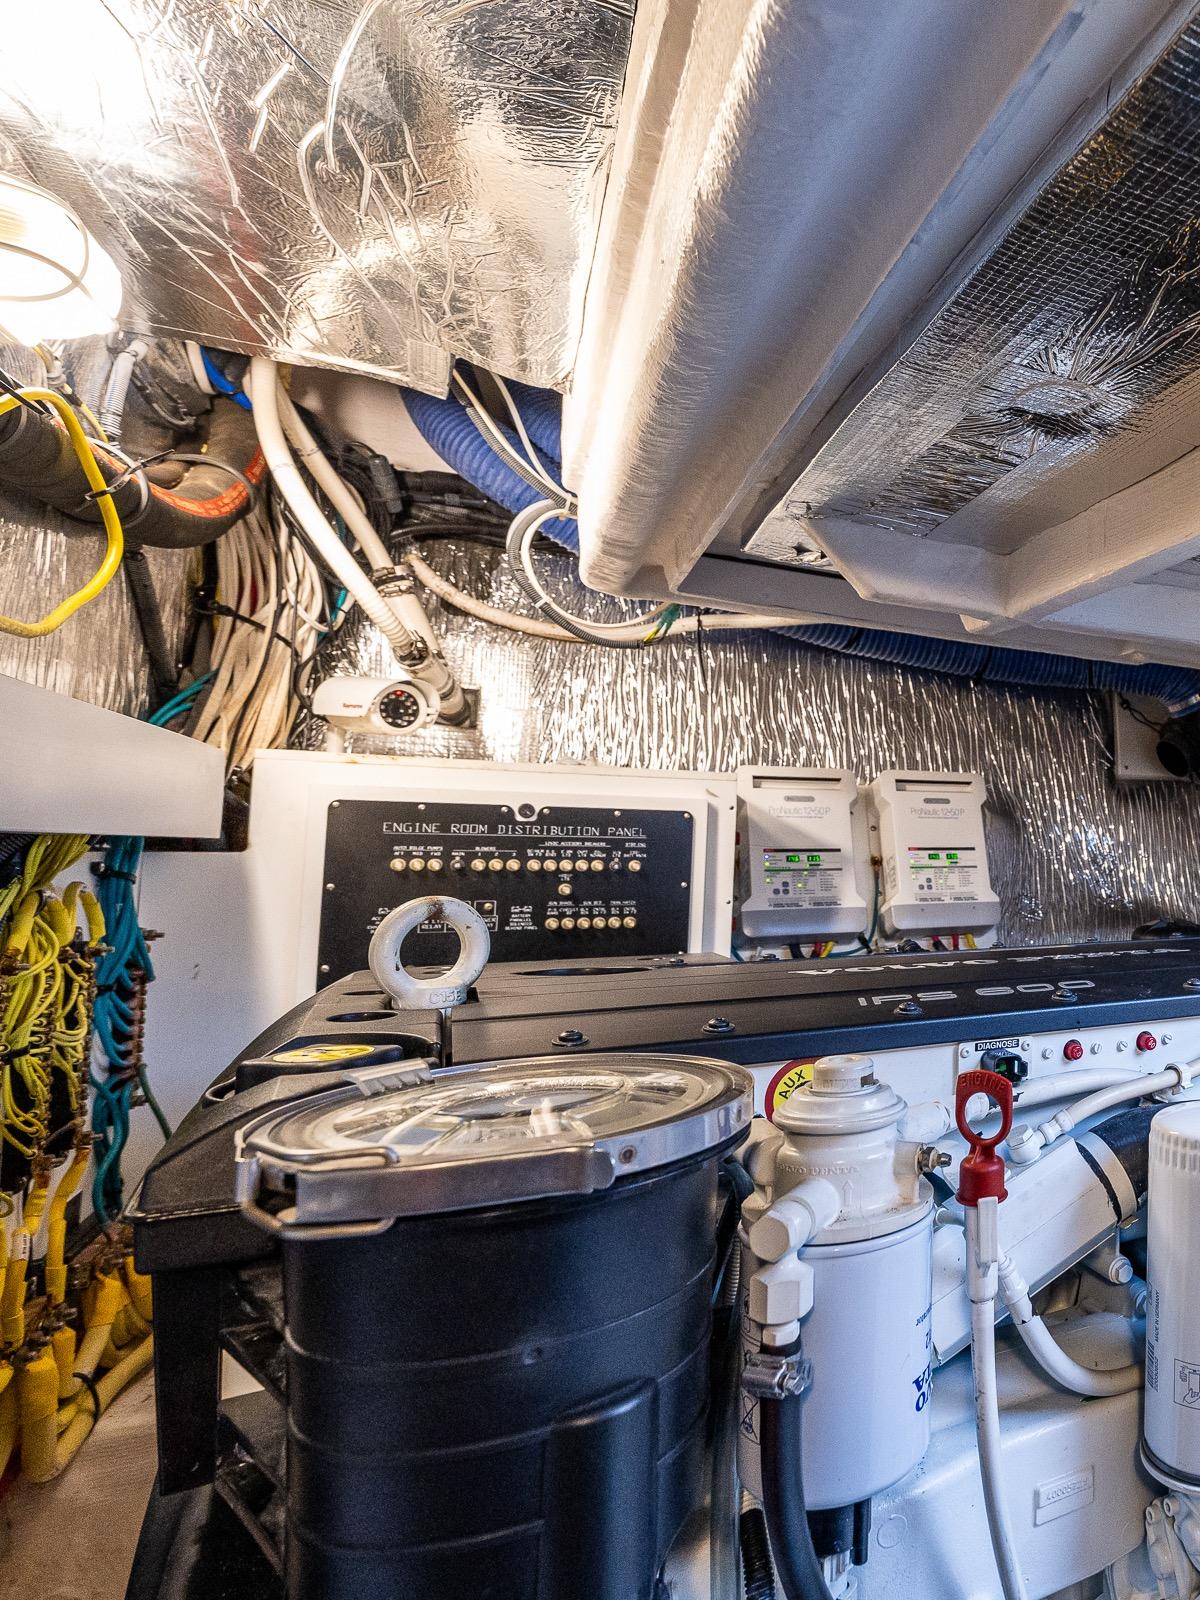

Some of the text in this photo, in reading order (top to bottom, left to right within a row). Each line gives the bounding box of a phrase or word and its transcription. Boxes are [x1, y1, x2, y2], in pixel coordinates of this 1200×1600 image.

[383, 822, 647, 838] ENGINE ROOM DISTRIBUTION PANEL
[787, 959, 999, 976] VOLVO
[857, 980, 1095, 1006] IPS 600
[977, 1039, 1018, 1051] DIAGNOSE
[778, 1069, 806, 1100] AUX
[959, 1072, 1008, 1091] ENGINE
